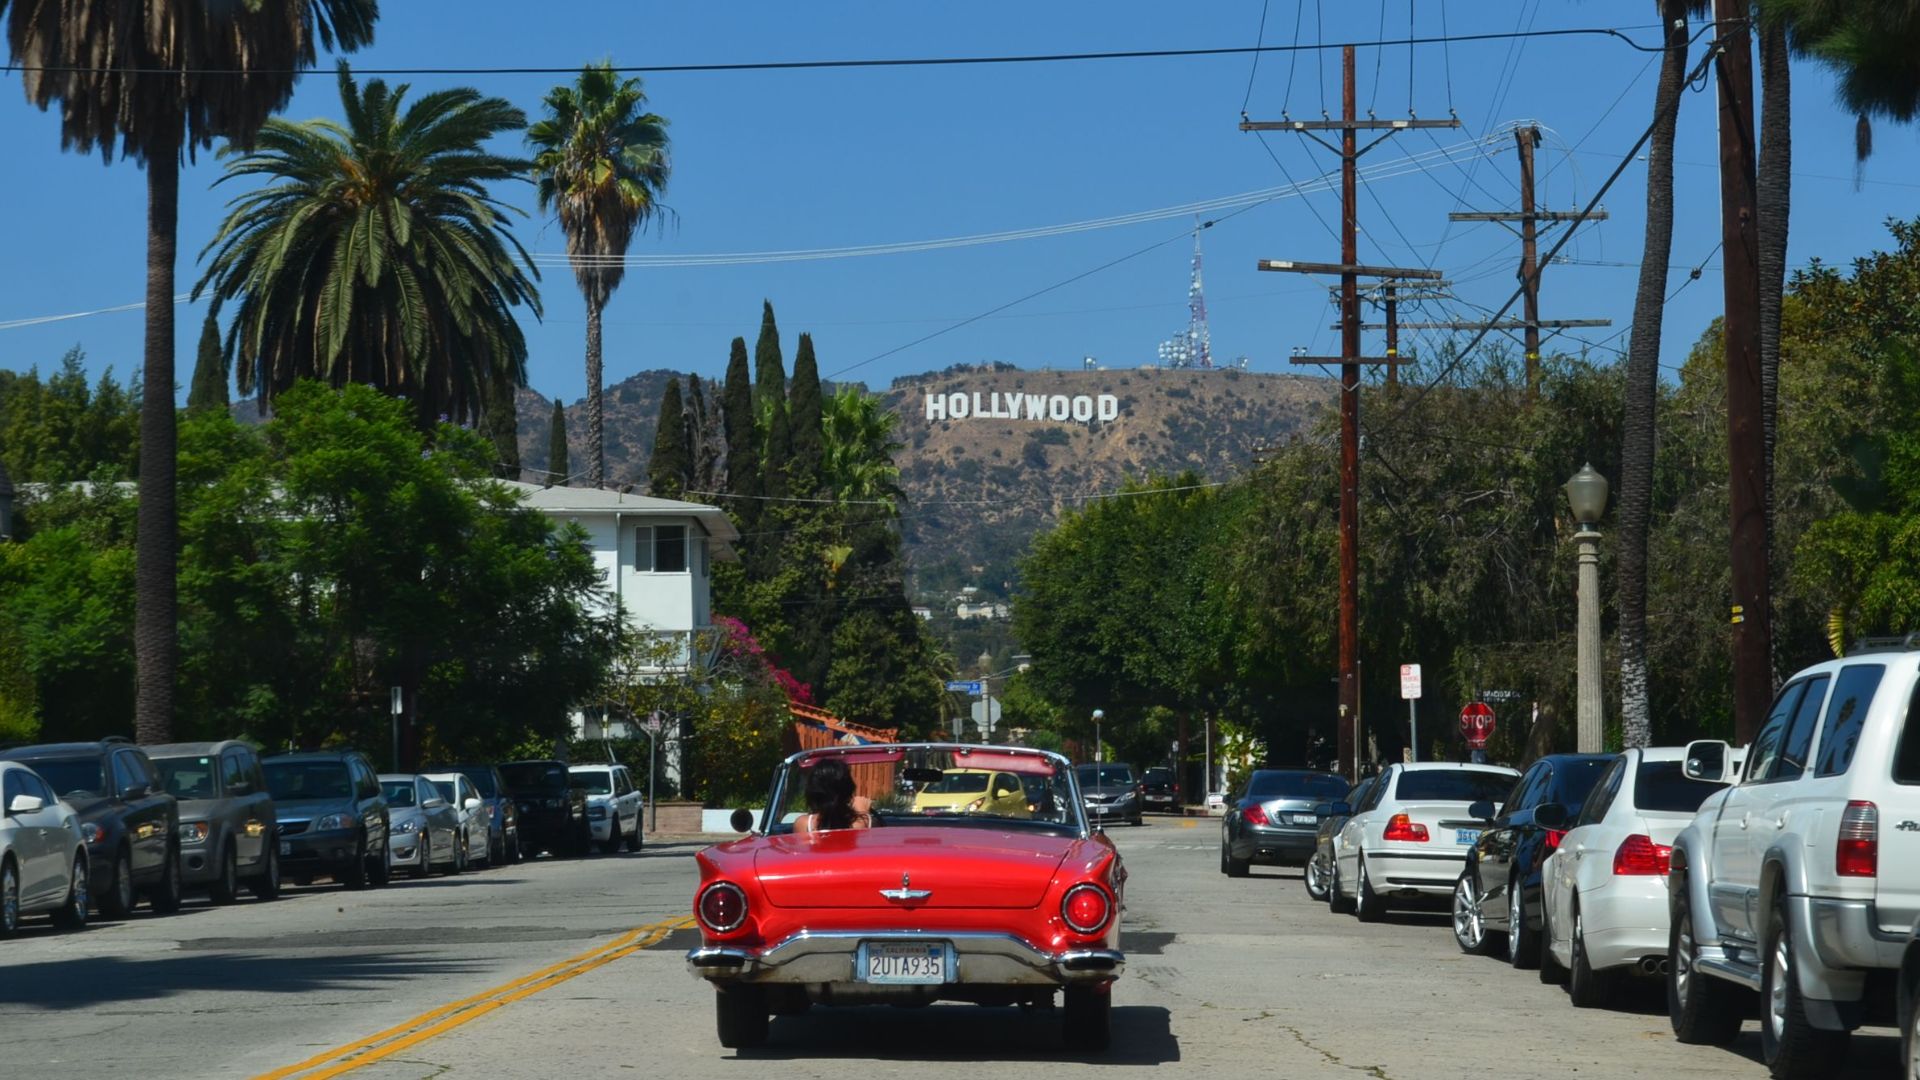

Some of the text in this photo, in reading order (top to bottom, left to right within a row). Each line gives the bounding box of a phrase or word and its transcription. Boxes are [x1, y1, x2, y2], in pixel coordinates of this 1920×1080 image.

[926, 391, 1119, 421] HOLLYWOOD
[1462, 714, 1492, 730] STOP
[886, 946, 926, 954] CALIFORNIA
[872, 957, 939, 976] 2UTA935
